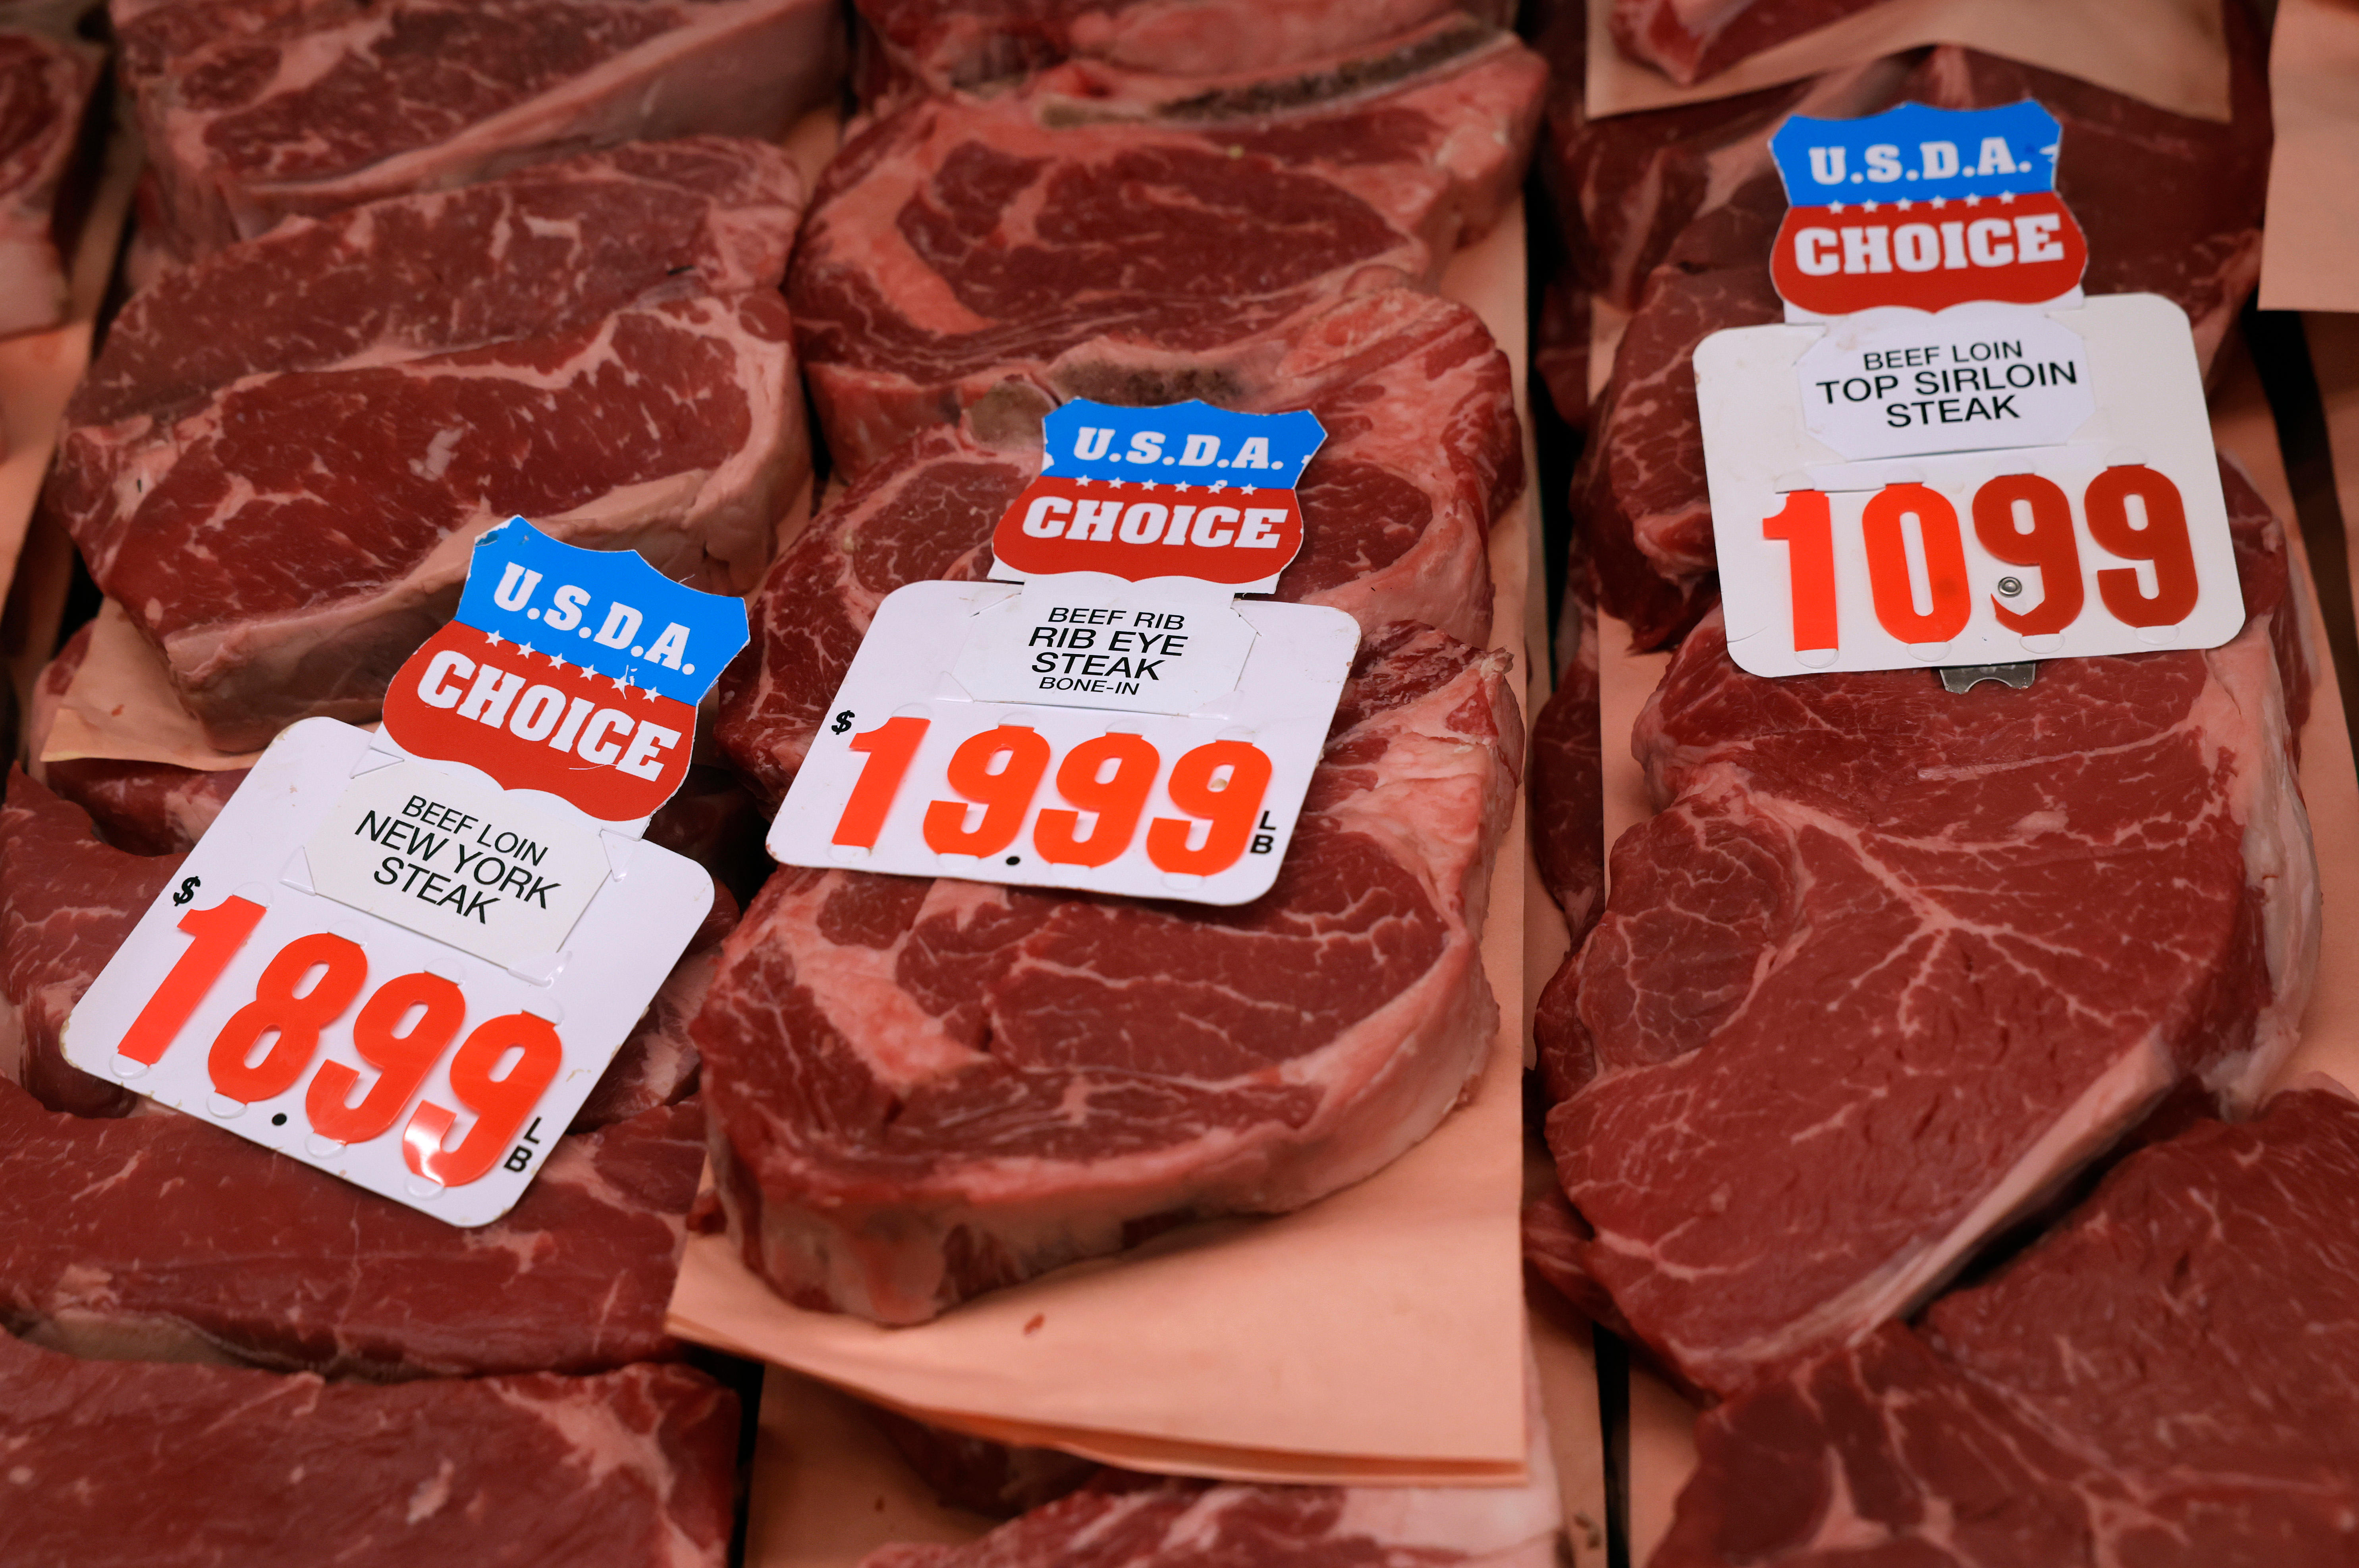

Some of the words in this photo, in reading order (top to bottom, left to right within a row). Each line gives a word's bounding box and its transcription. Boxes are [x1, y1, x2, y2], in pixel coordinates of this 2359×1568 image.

[1809, 137, 2031, 185] U.S.D.A.
[1794, 214, 2064, 276] CHOICE
[1863, 346, 1941, 371] BEEF
[1951, 341, 2023, 363] LOIN
[1816, 375, 1900, 405] TOP
[1914, 362, 2077, 395] SIRLOIN
[1886, 396, 2021, 428] STEAK
[1073, 426, 1283, 470] U.S.D.A.
[1022, 496, 1288, 549] CHOICE
[1762, 464, 2198, 651] 1099
[492, 561, 696, 675] U.S.D.A.
[1029, 627, 1098, 649] RIB
[1108, 632, 1188, 656] EYE
[1047, 607, 1126, 625] BEEF
[1134, 611, 1185, 630] RIB
[1032, 653, 1166, 680] STEAK
[1038, 677, 1140, 695] BONE-IN
[417, 650, 680, 781] CHOICE
[402, 794, 478, 834] BEEF
[482, 821, 548, 866] LOIN
[355, 810, 447, 870] NEW
[456, 844, 561, 909] YORK
[373, 857, 501, 924] STEAK
